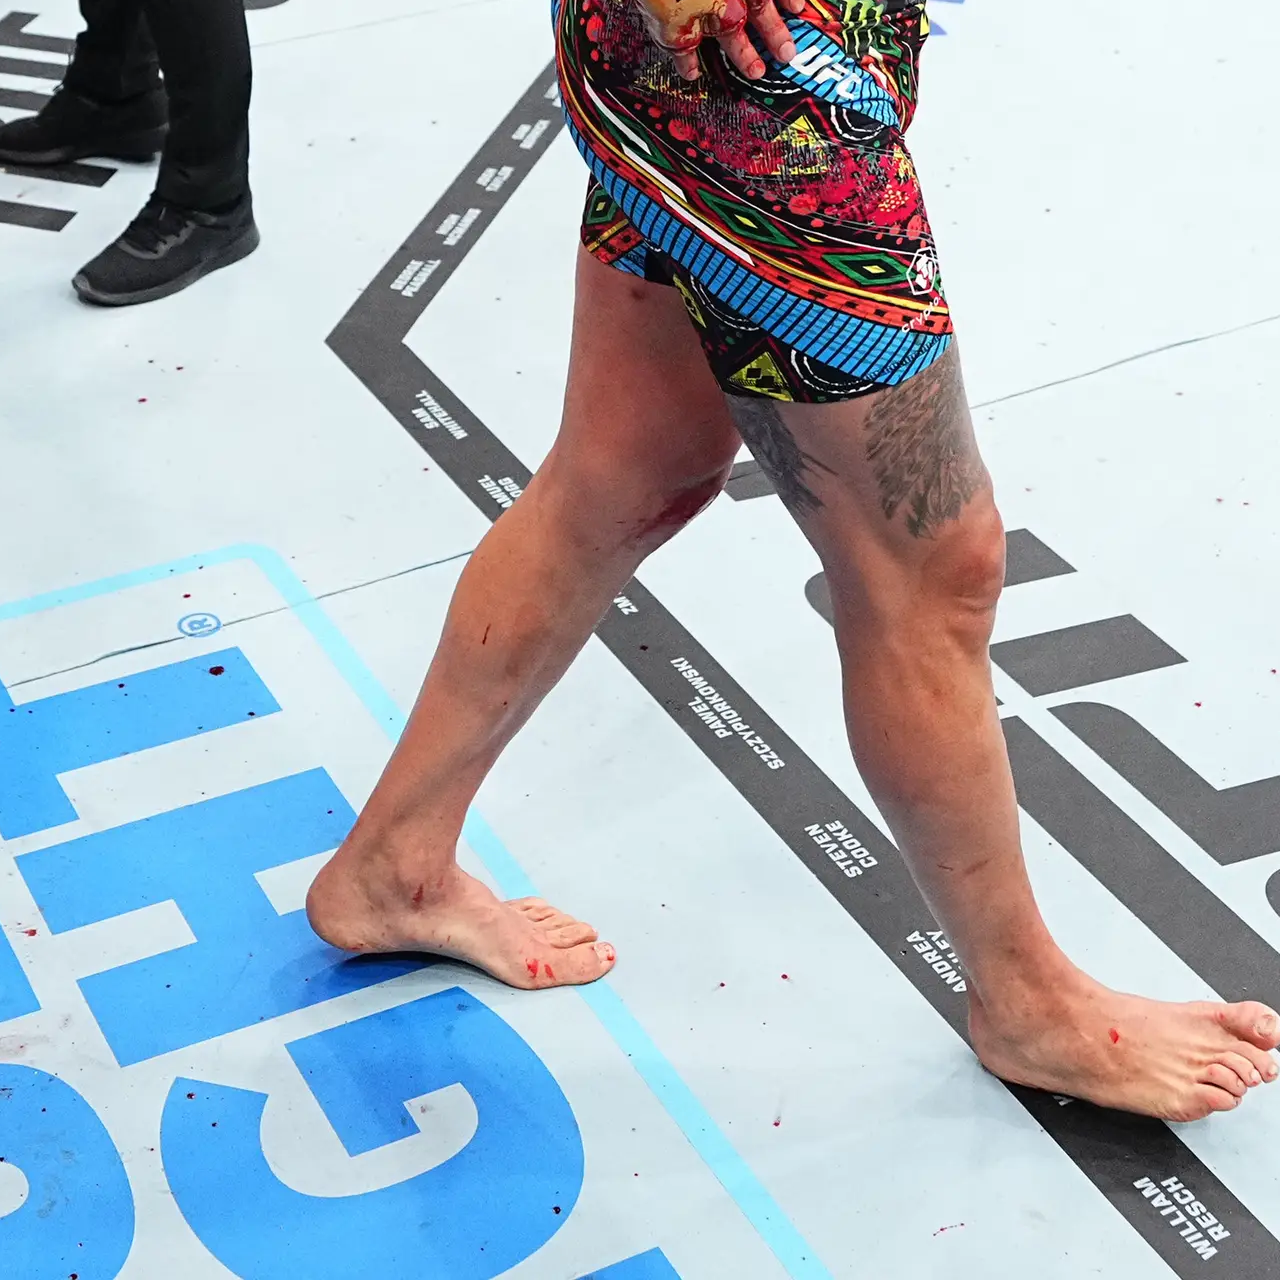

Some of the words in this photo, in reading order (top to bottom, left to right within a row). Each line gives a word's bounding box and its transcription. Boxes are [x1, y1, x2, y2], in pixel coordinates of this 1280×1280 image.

[787, 45, 864, 99] UFC
[411, 407, 440, 430] SAM
[415, 390, 468, 440] WHITEHALL
[477, 474, 513, 508] AMUEL
[670, 657, 785, 770] SZCZYPIORKOWSKI
[687, 696, 733, 739] PAWEL
[804, 823, 863, 878] STEVEN
[825, 819, 878, 868] COOKE
[906, 930, 967, 993] ANDREA
[1132, 1176, 1218, 1261] WILLIAM
[1160, 1175, 1231, 1242] RESCH
